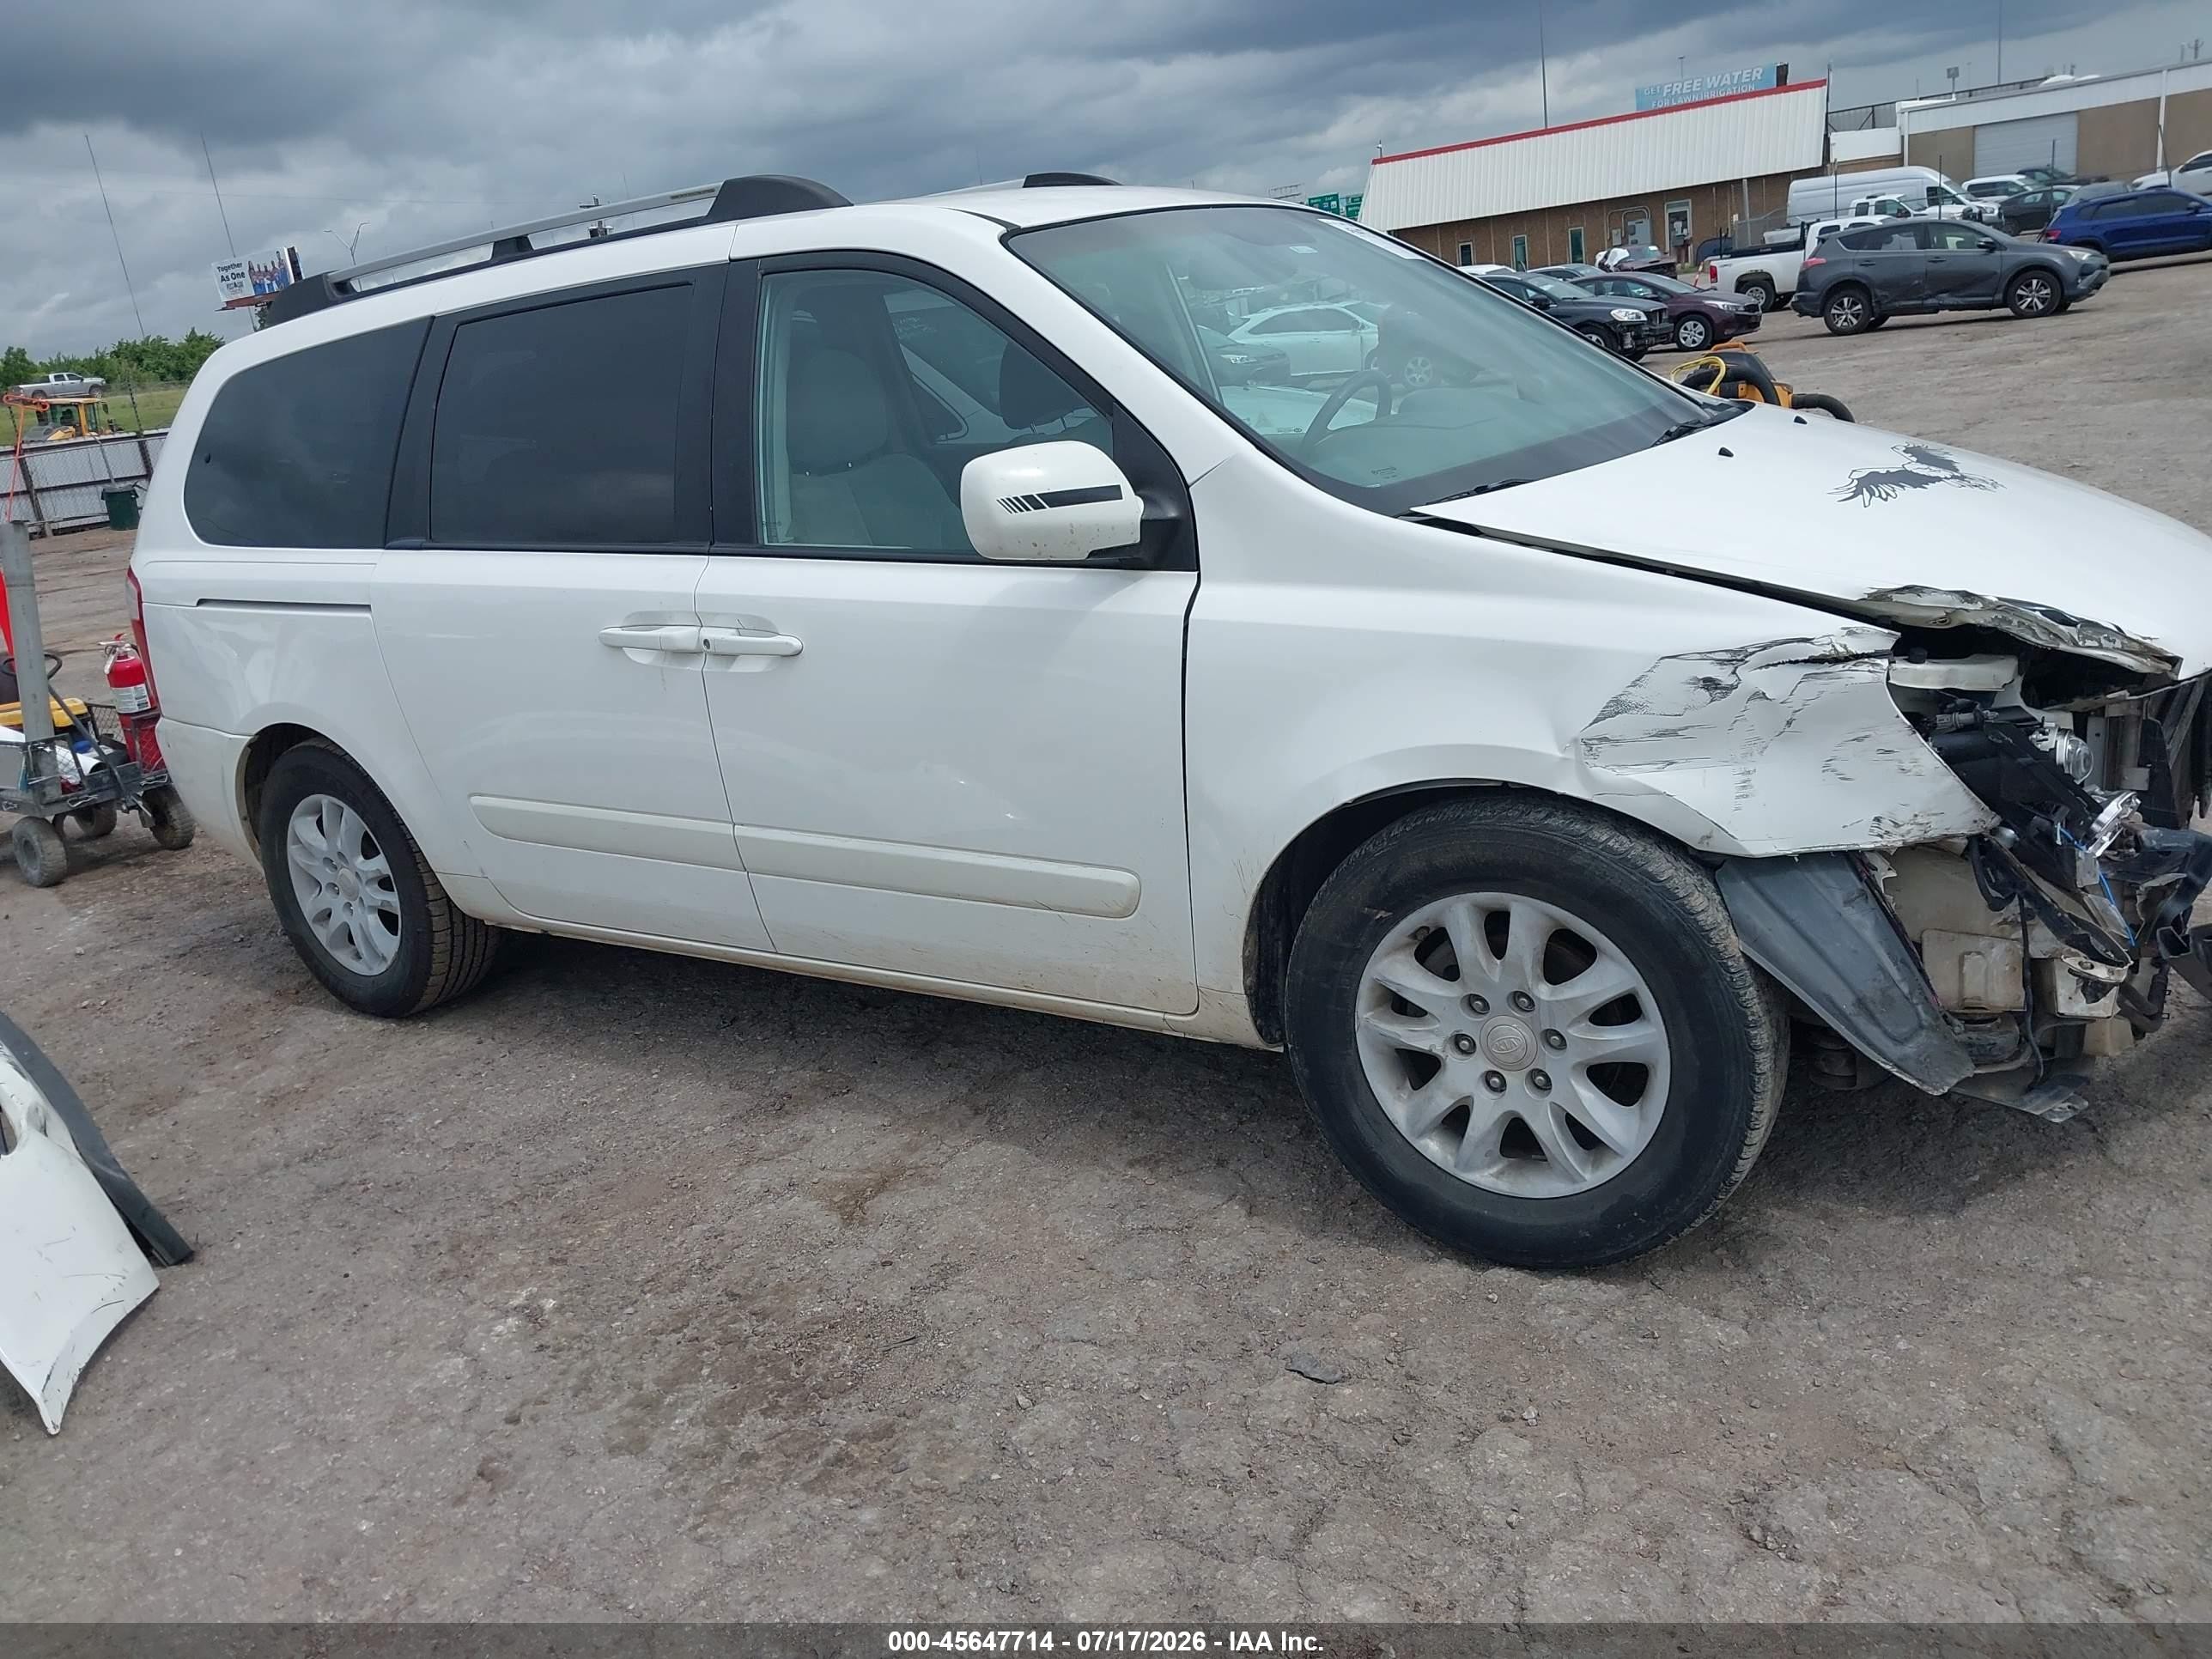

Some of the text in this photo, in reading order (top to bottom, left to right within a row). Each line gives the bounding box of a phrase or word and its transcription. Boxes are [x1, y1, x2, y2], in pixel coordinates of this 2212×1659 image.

[1662, 78, 1703, 97] FREE
[1706, 67, 1763, 89] WATER
[1652, 82, 1755, 109] FOR LAWN IRRIGATION
[217, 263, 242, 272] Together
[231, 271, 246, 280] One
[1493, 1037, 1522, 1052] KIA
